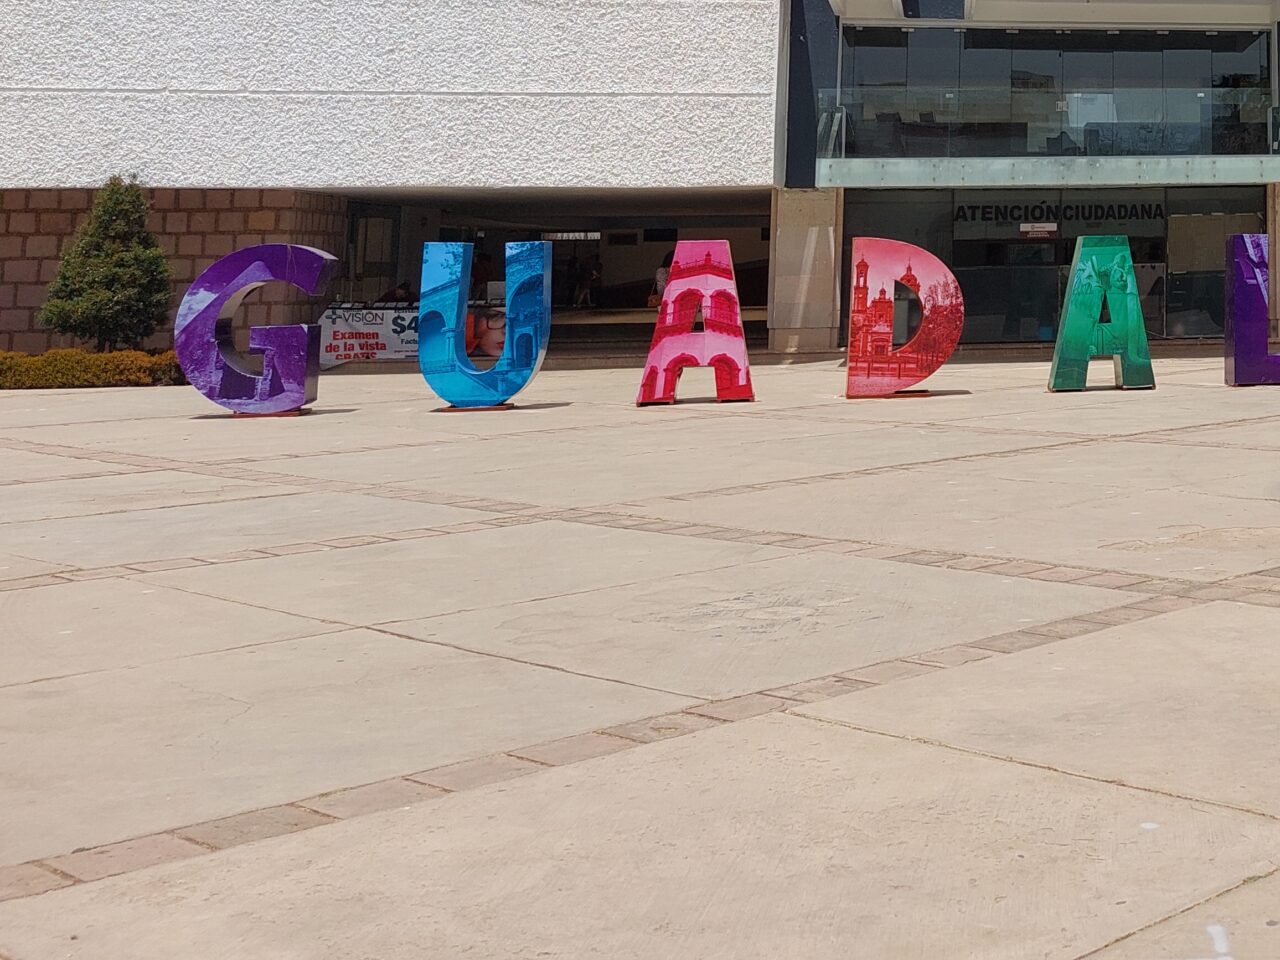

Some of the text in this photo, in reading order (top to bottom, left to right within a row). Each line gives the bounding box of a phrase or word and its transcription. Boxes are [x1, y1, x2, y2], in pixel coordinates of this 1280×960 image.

[953, 200, 1165, 222] ATENCIÓN CIUDADANA
[333, 330, 379, 340] Examen
[325, 341, 387, 353] de la vista
